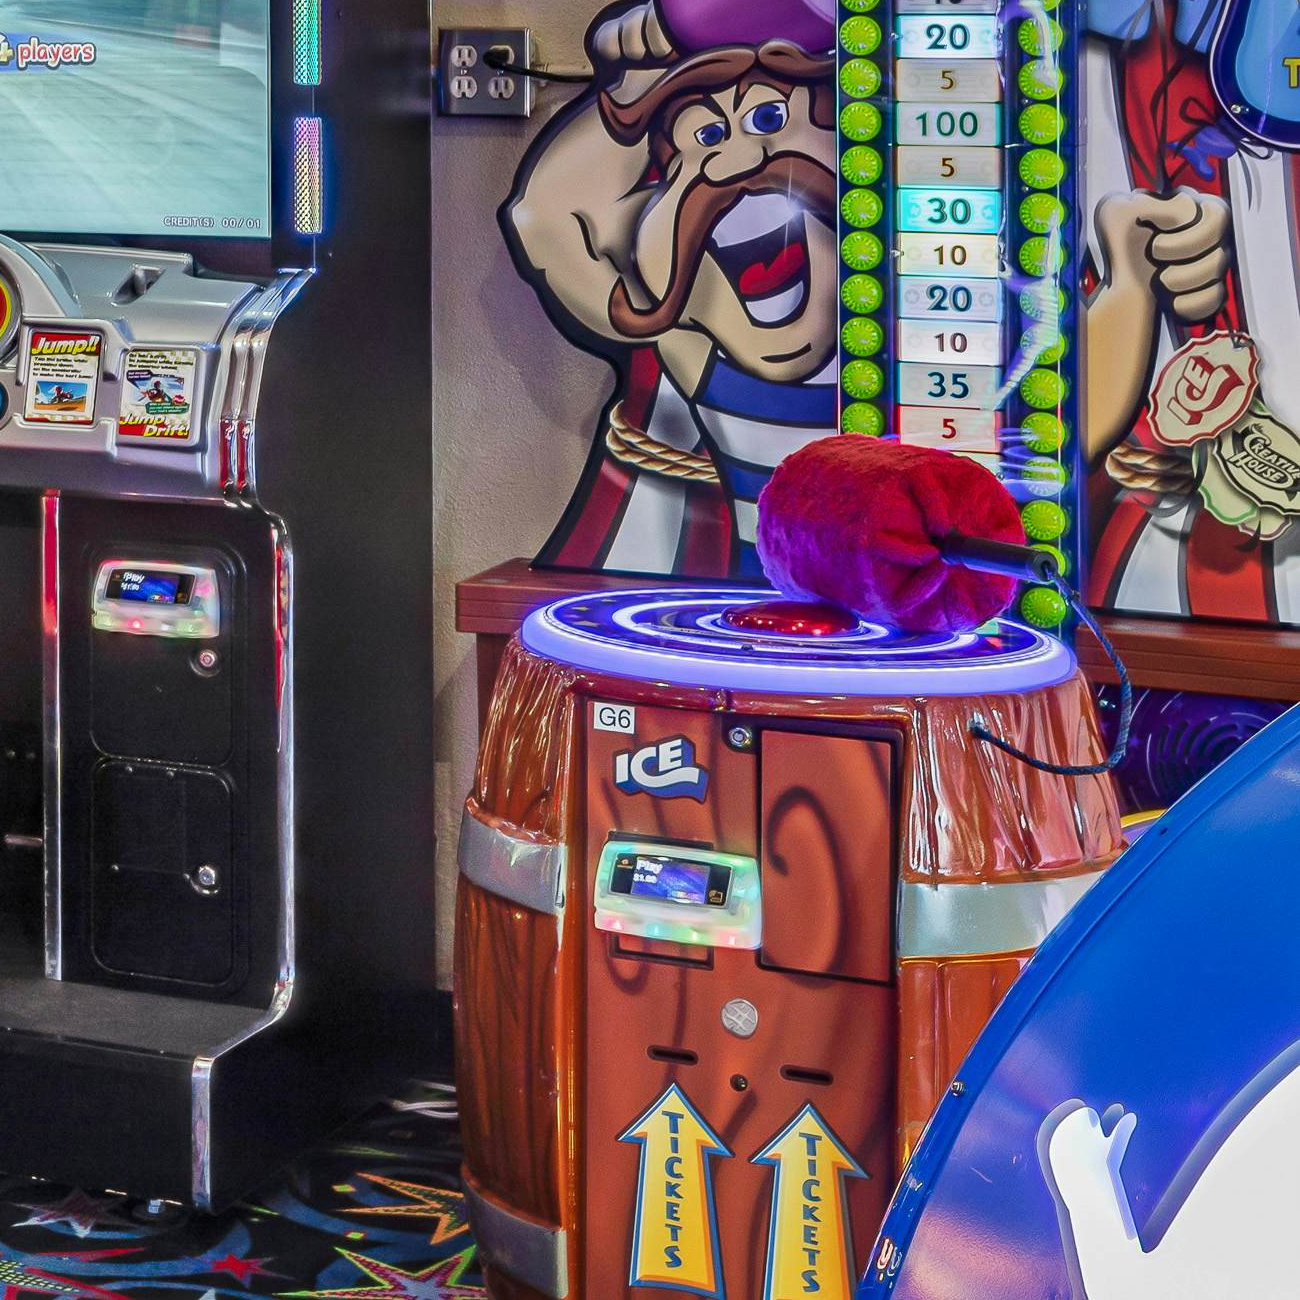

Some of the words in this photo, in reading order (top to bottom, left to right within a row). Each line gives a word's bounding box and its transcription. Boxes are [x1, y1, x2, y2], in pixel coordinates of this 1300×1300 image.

[926, 24, 969, 50] 20
[17, 38, 96, 68] players
[915, 111, 979, 138] 100
[164, 216, 215, 228] CREDIT(S)
[927, 198, 971, 225] 30
[933, 245, 967, 267] 10
[926, 285, 972, 314] 20
[927, 372, 970, 400] 35
[1166, 354, 1245, 426] ICE
[941, 417, 957, 439] 5
[1228, 451, 1285, 484] HOUSE
[599, 706, 632, 730] G6
[615, 737, 702, 790] ICE
[661, 1110, 685, 1269] TICKETS
[797, 1131, 821, 1294] TICKETS
